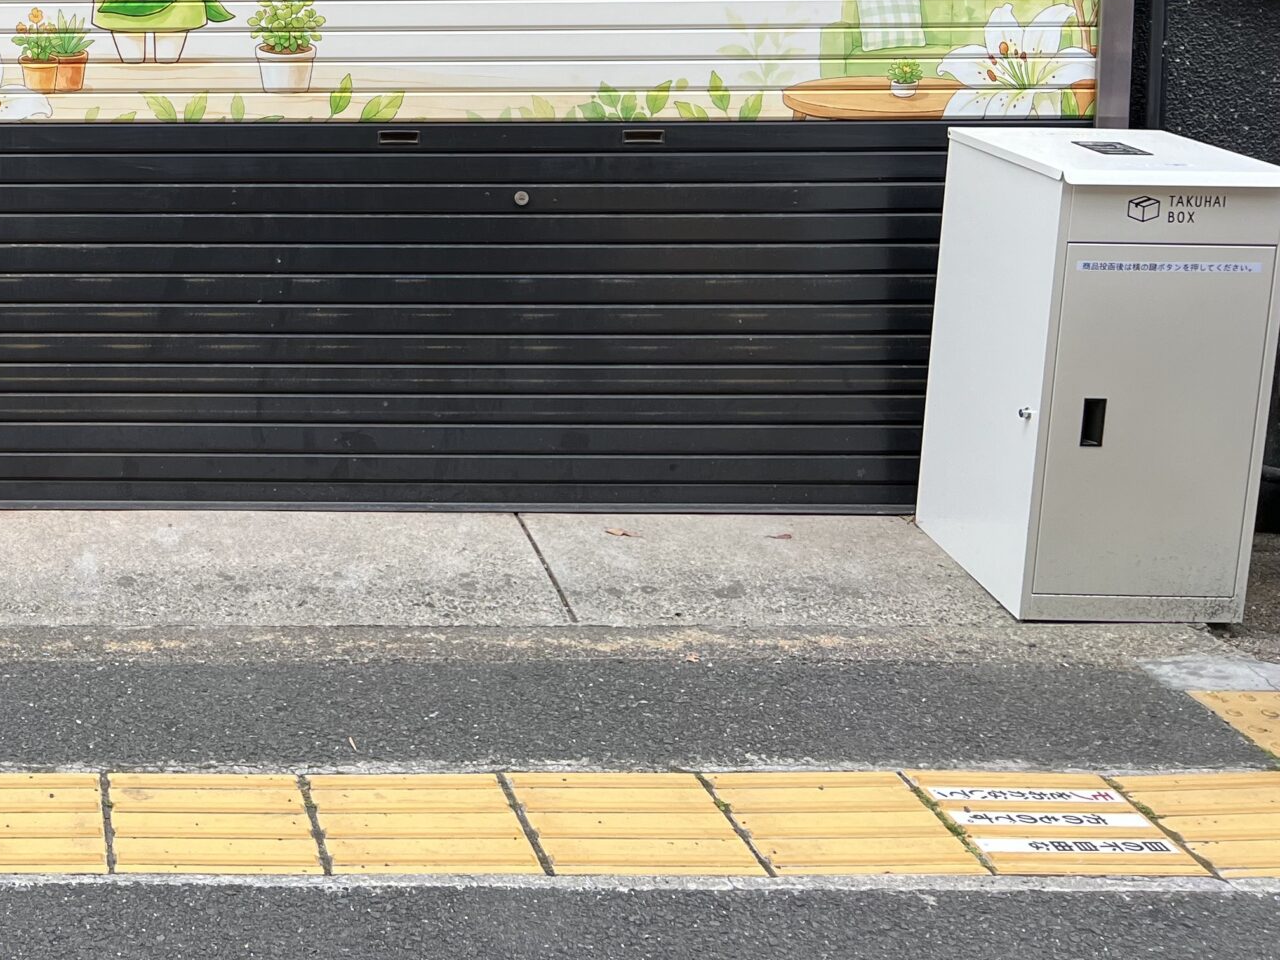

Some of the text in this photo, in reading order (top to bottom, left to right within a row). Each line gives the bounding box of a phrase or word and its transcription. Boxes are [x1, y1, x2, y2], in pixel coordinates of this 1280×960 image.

[1169, 195, 1227, 208] TAKUHAI
[1167, 211, 1196, 224] BOX
[1028, 840, 1171, 852] 目の不自由な
